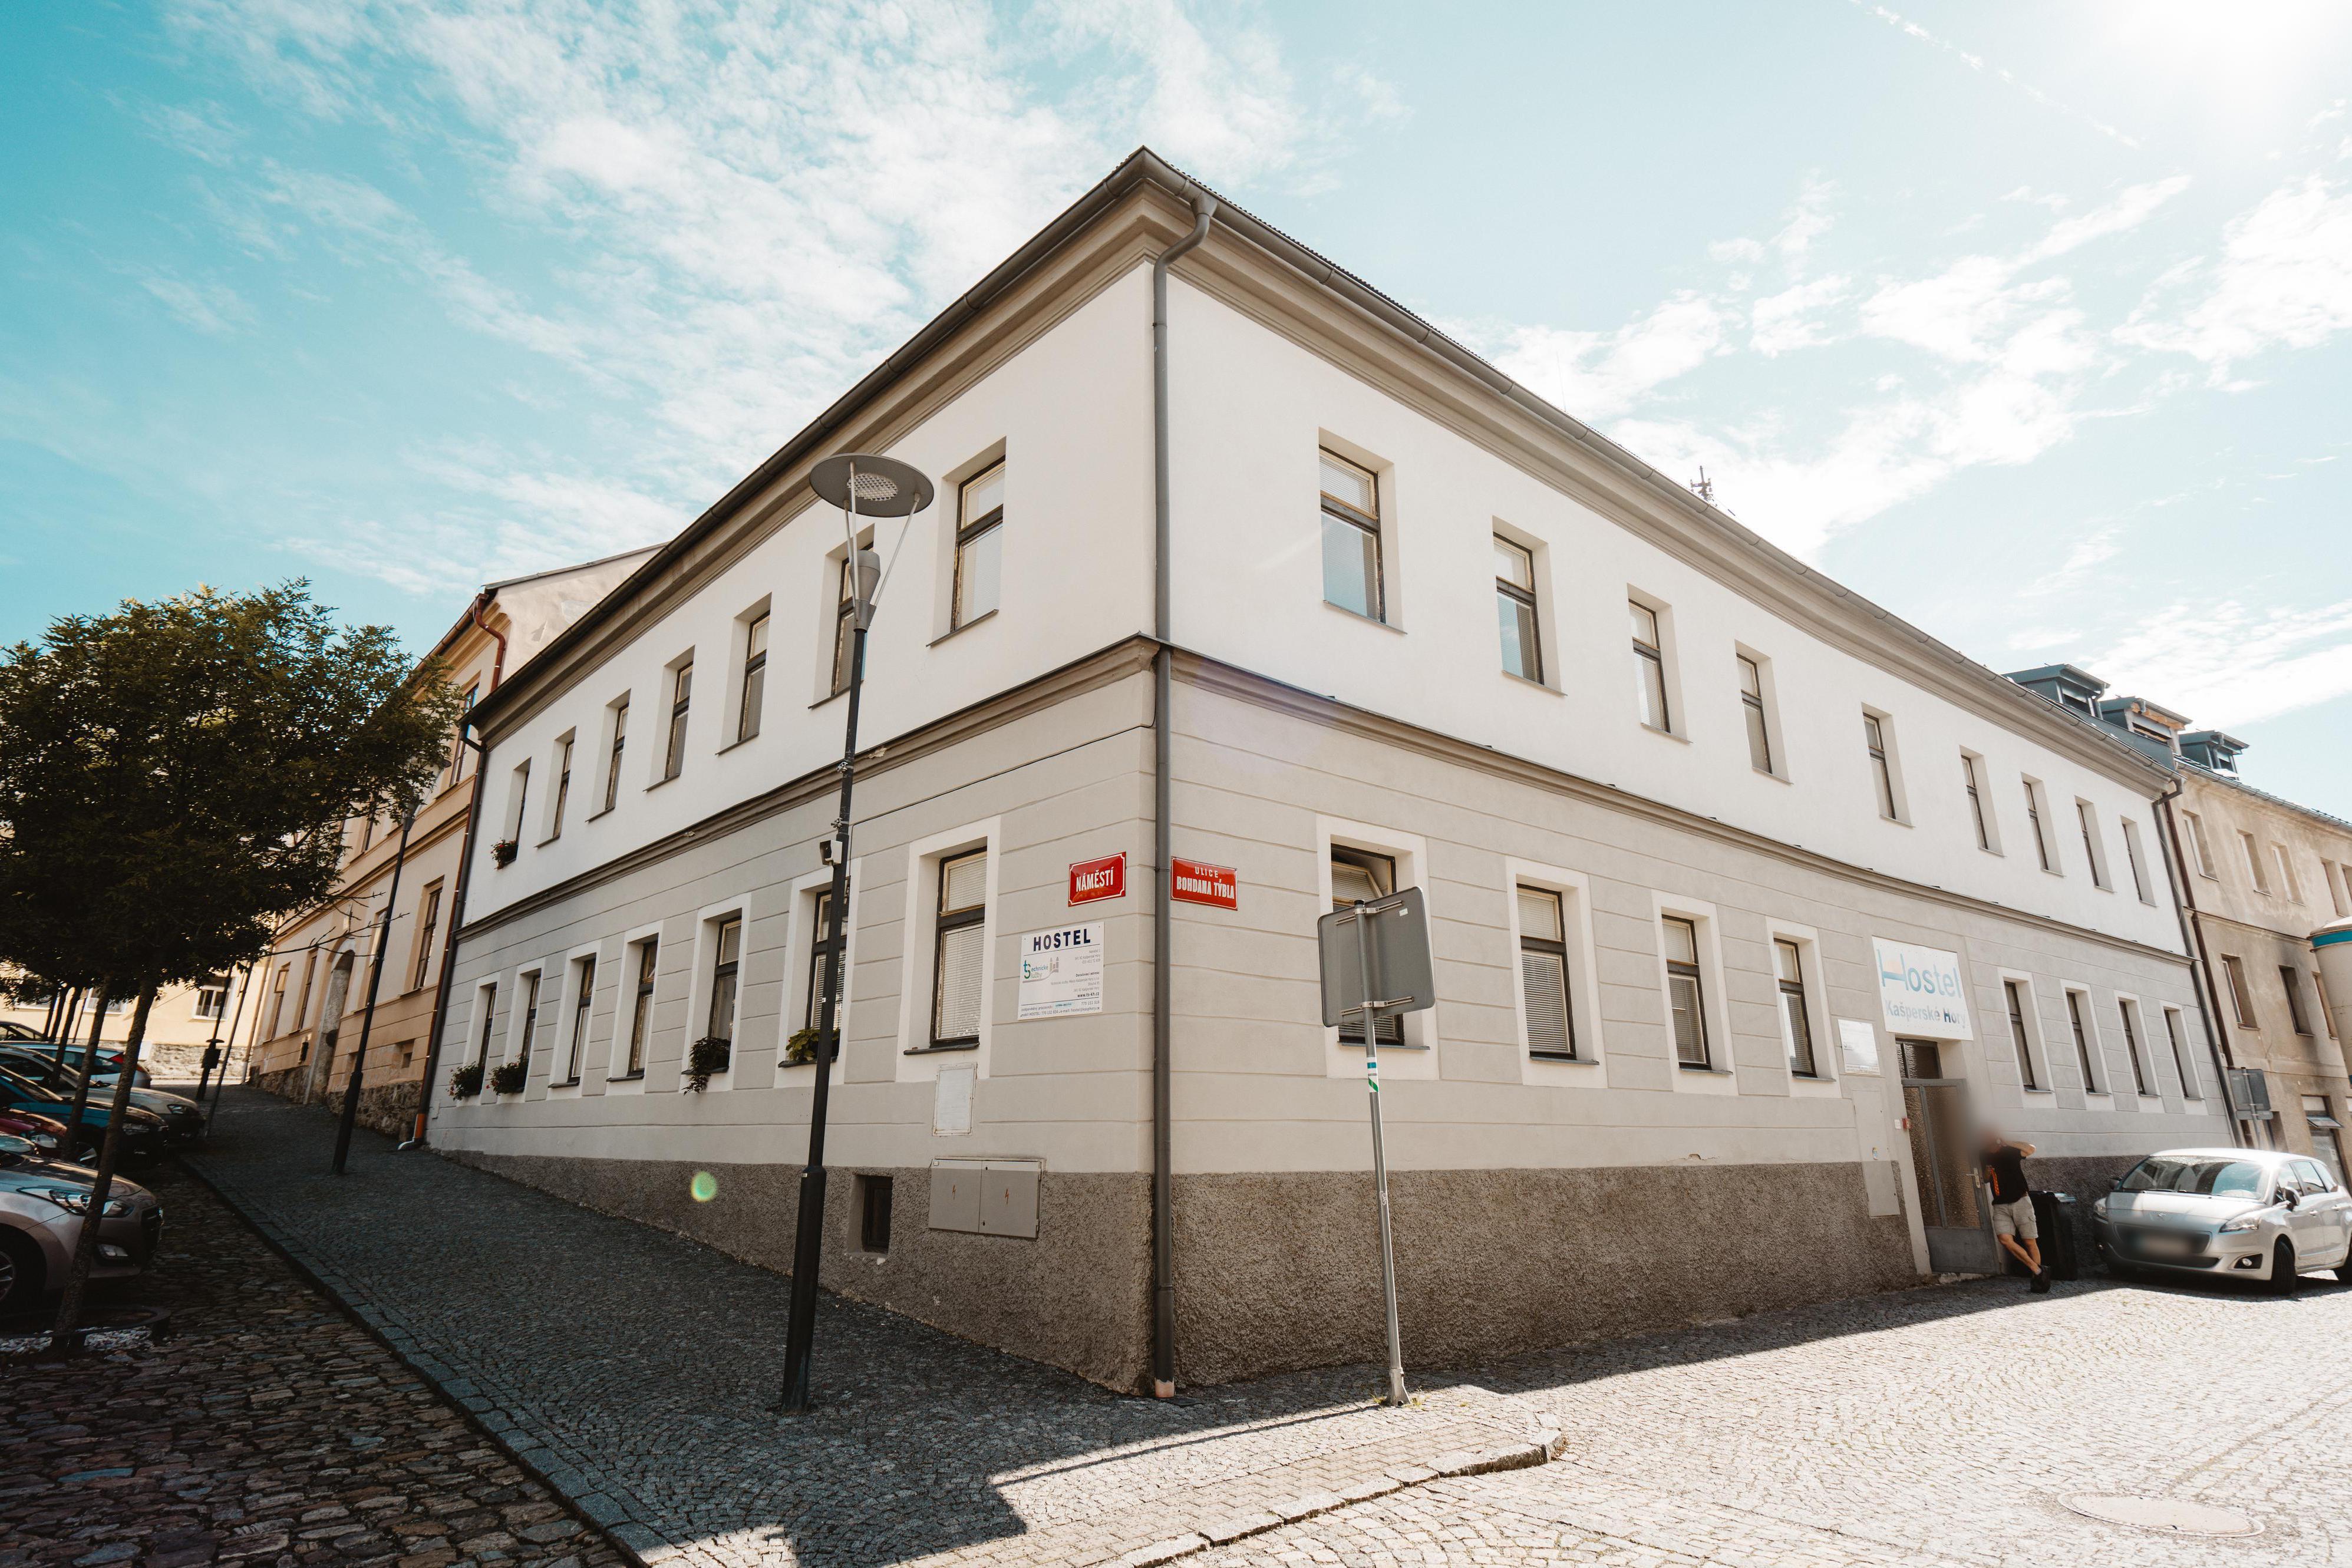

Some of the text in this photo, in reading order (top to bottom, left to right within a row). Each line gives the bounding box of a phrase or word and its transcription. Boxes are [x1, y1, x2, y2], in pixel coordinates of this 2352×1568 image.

[1076, 867, 1114, 892] NÁMĚSTÍ
[1195, 866, 1219, 878] ULICE
[1177, 876, 1235, 899] BOHDANA TÝBLA
[1033, 929, 1091, 952] HOSTEL
[1877, 949, 1962, 999] Hostel
[1886, 999, 1966, 1029] Kašperské Hory
